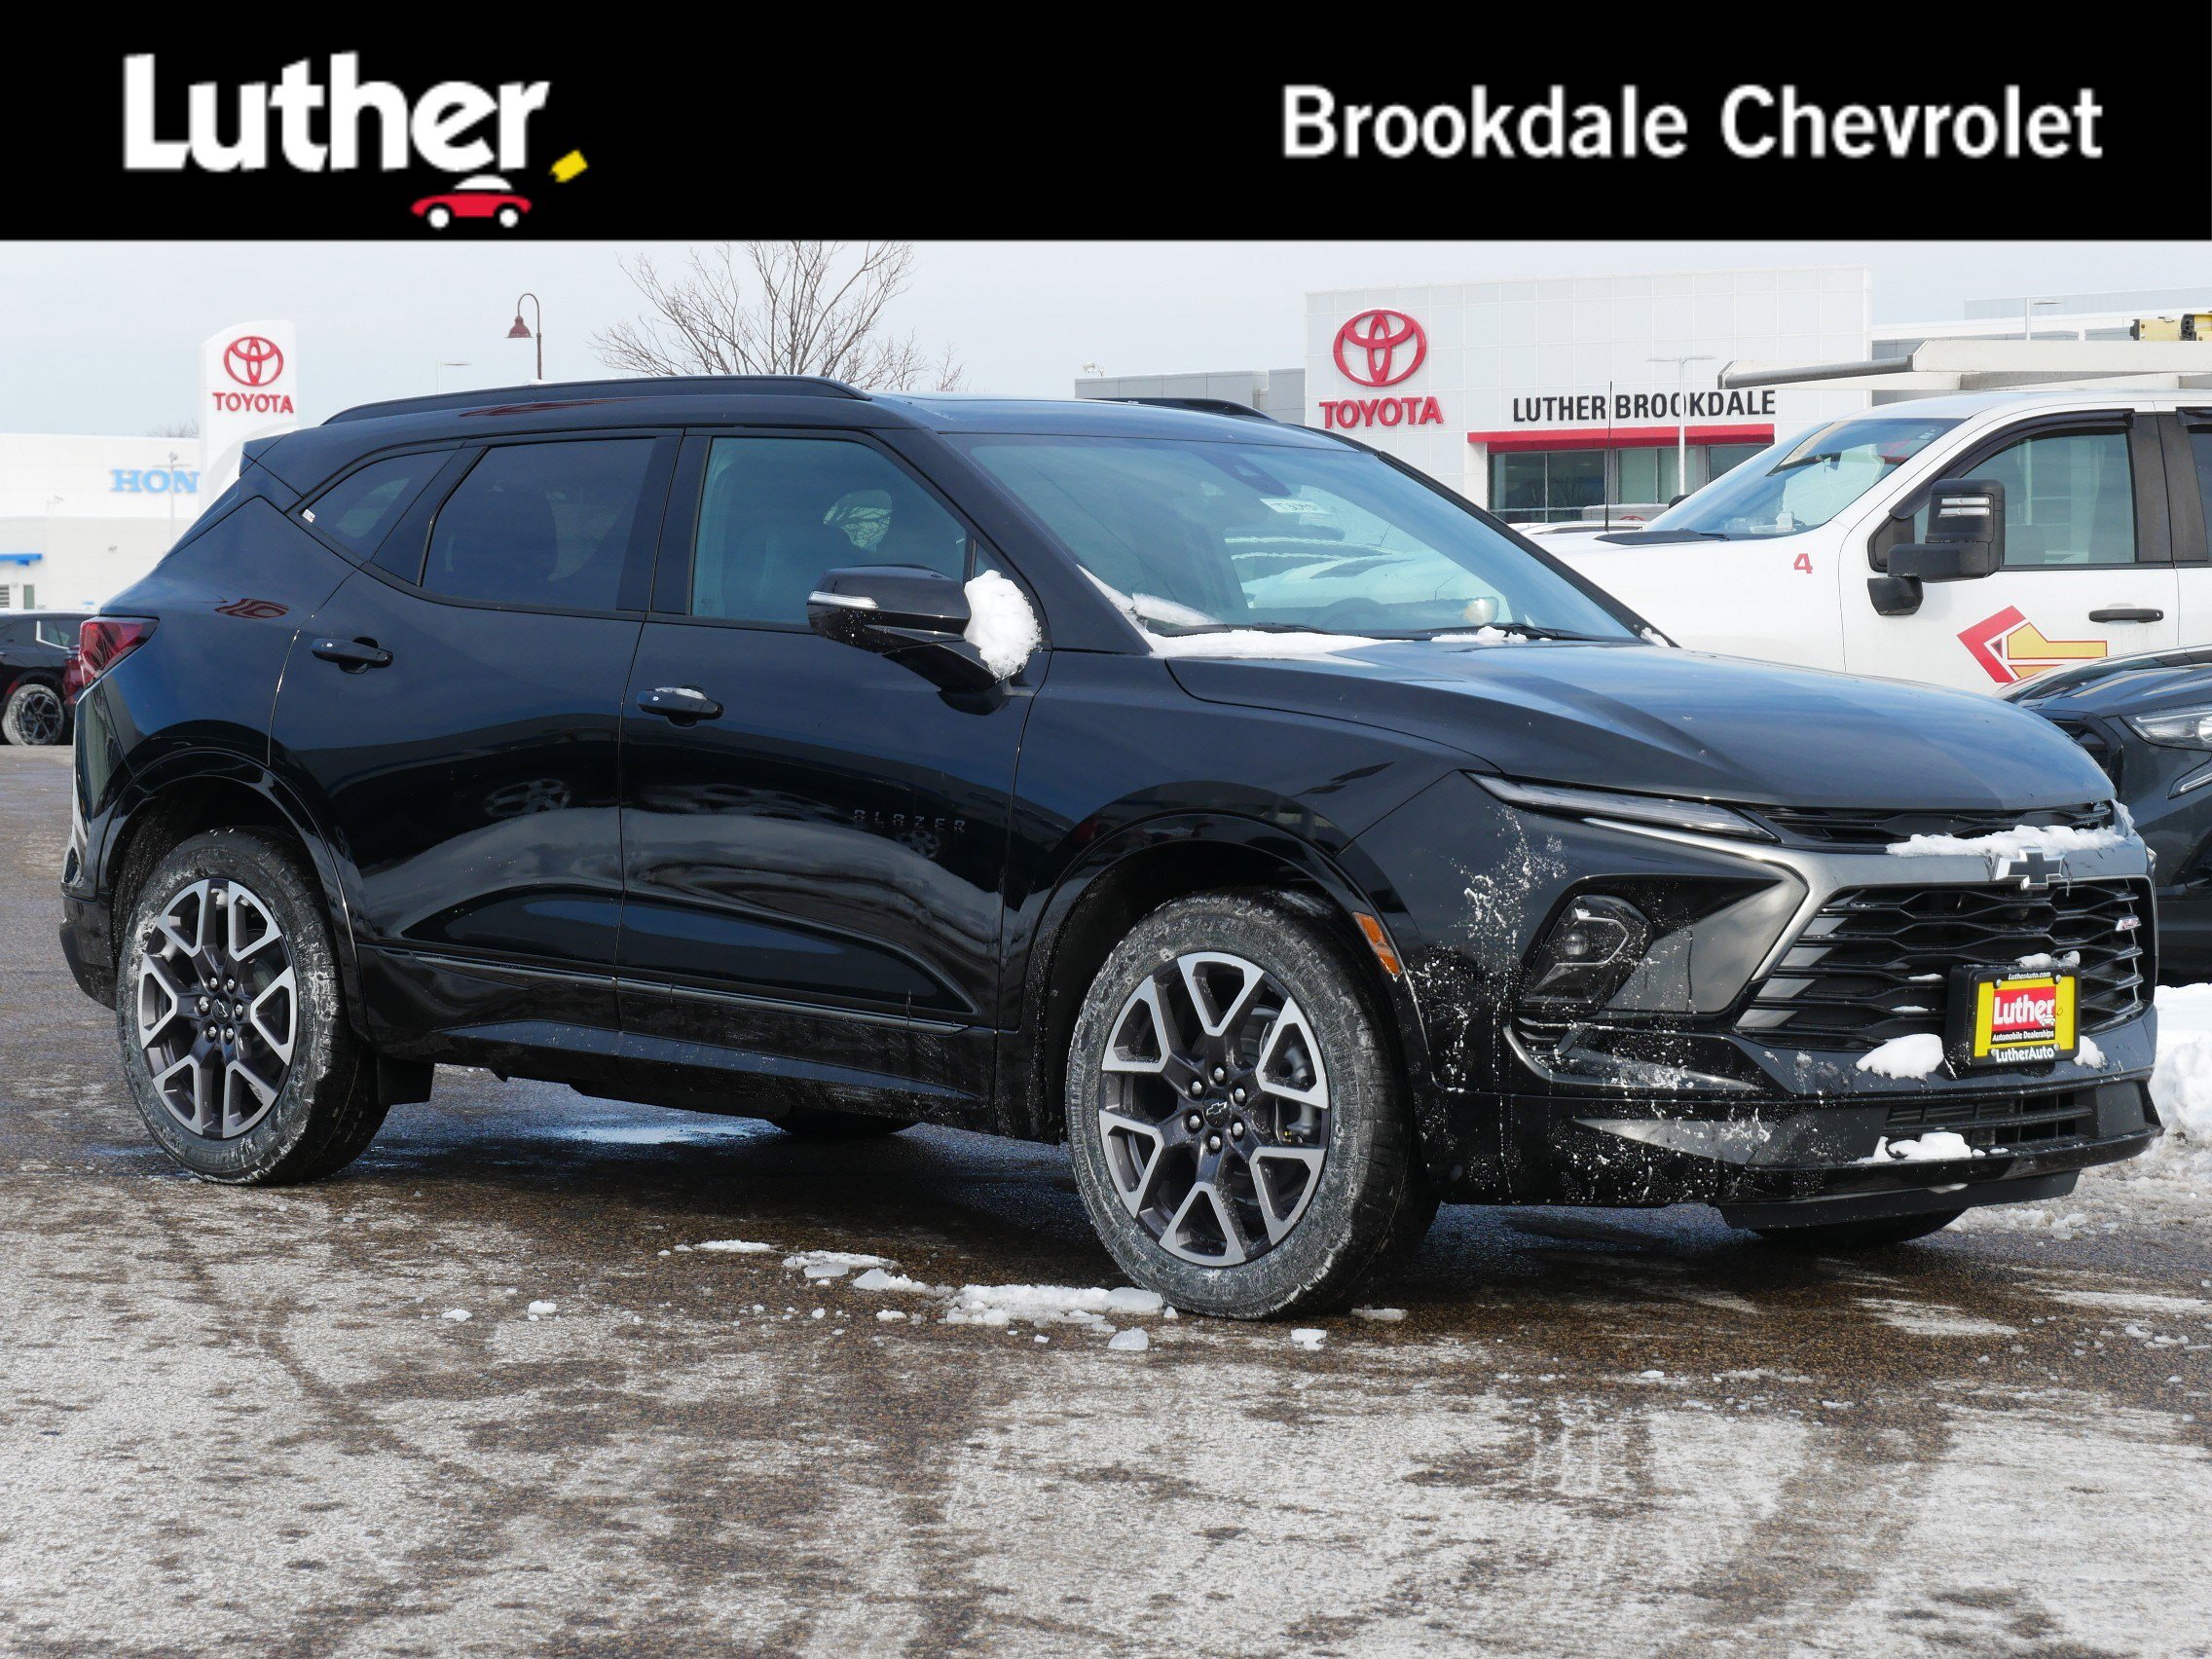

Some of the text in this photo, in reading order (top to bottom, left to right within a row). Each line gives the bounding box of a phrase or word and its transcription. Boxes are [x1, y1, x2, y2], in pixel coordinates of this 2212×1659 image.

[212, 391, 294, 414] TOYOTA
[1318, 395, 1445, 429] TOYOTA
[1513, 389, 1776, 423] LUTHER BROOKDALE
[109, 468, 200, 494] HON
[1793, 552, 1814, 574] 4
[854, 809, 966, 832] BLAZER
[1993, 994, 2056, 1026] Luther
[1992, 1029, 2054, 1042] Automobile Dealerships
[1995, 1046, 2055, 1063] LutherAuto
